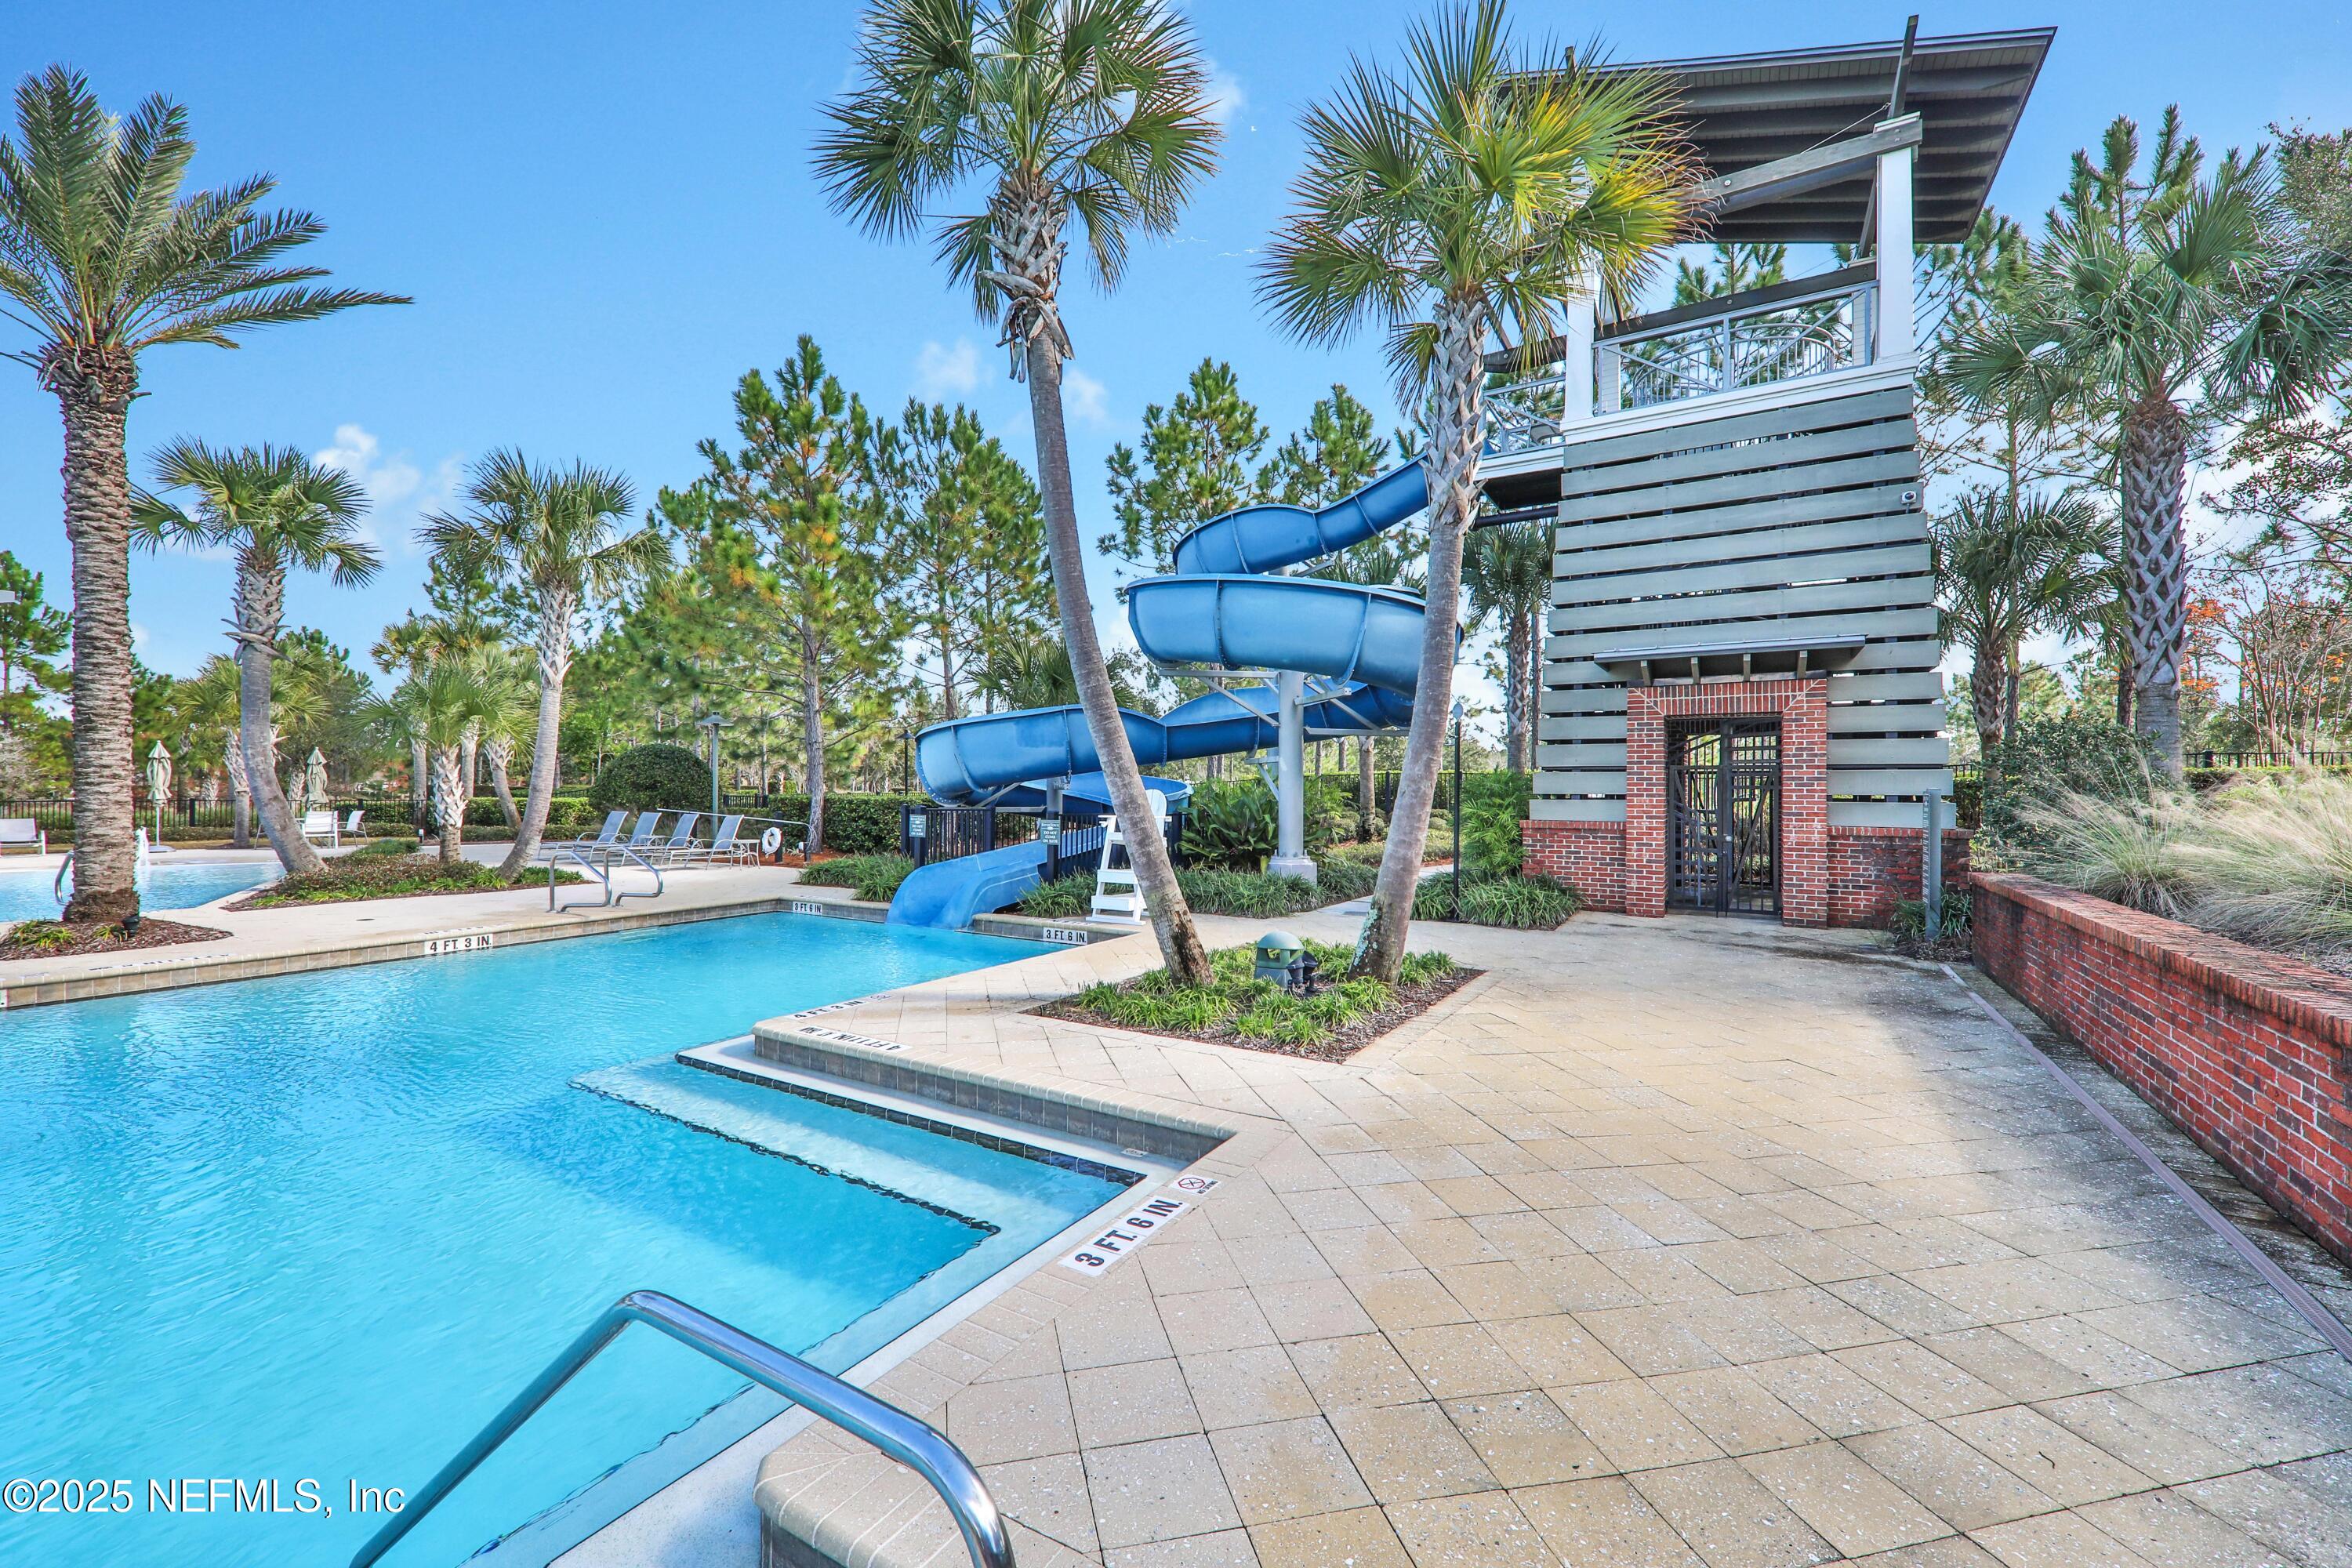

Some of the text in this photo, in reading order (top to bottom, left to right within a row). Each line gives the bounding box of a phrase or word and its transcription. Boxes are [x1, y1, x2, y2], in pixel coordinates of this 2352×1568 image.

[1046, 929, 1051, 938] 3
[1068, 931, 1073, 941] 6
[430, 942, 437, 952] 4
[465, 938, 472, 948] 3
[1075, 1252, 1105, 1267] 3
[1126, 1217, 1155, 1229] 6
